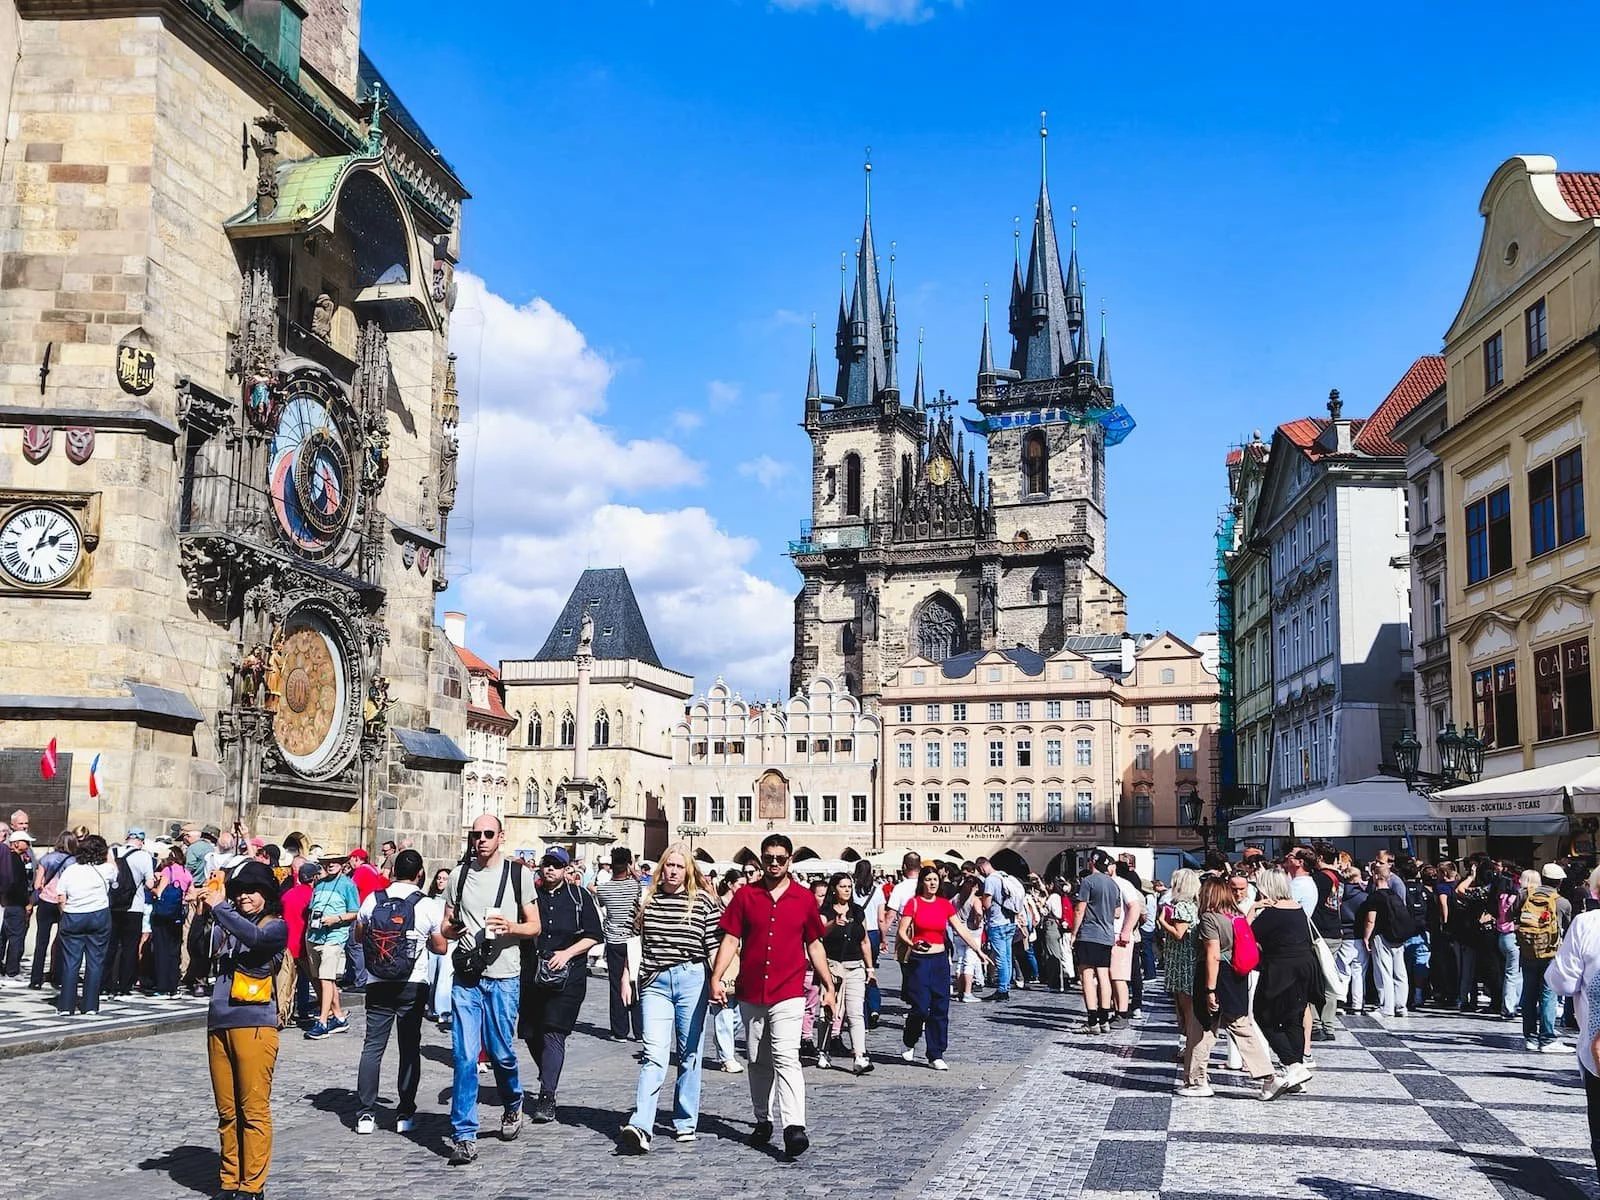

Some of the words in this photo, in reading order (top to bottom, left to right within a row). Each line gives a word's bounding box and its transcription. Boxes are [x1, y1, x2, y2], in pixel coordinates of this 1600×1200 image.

[1538, 645, 1590, 677] CAFE
[1449, 804, 1476, 813] BURGERS
[1480, 802, 1513, 812] COCKTAILS
[1517, 800, 1541, 810] STEAKS
[932, 825, 951, 833] DALI
[969, 825, 1001, 833] MUCHA
[1020, 824, 1059, 833] WARHOL
[1413, 824, 1449, 832] COCKTAIL
